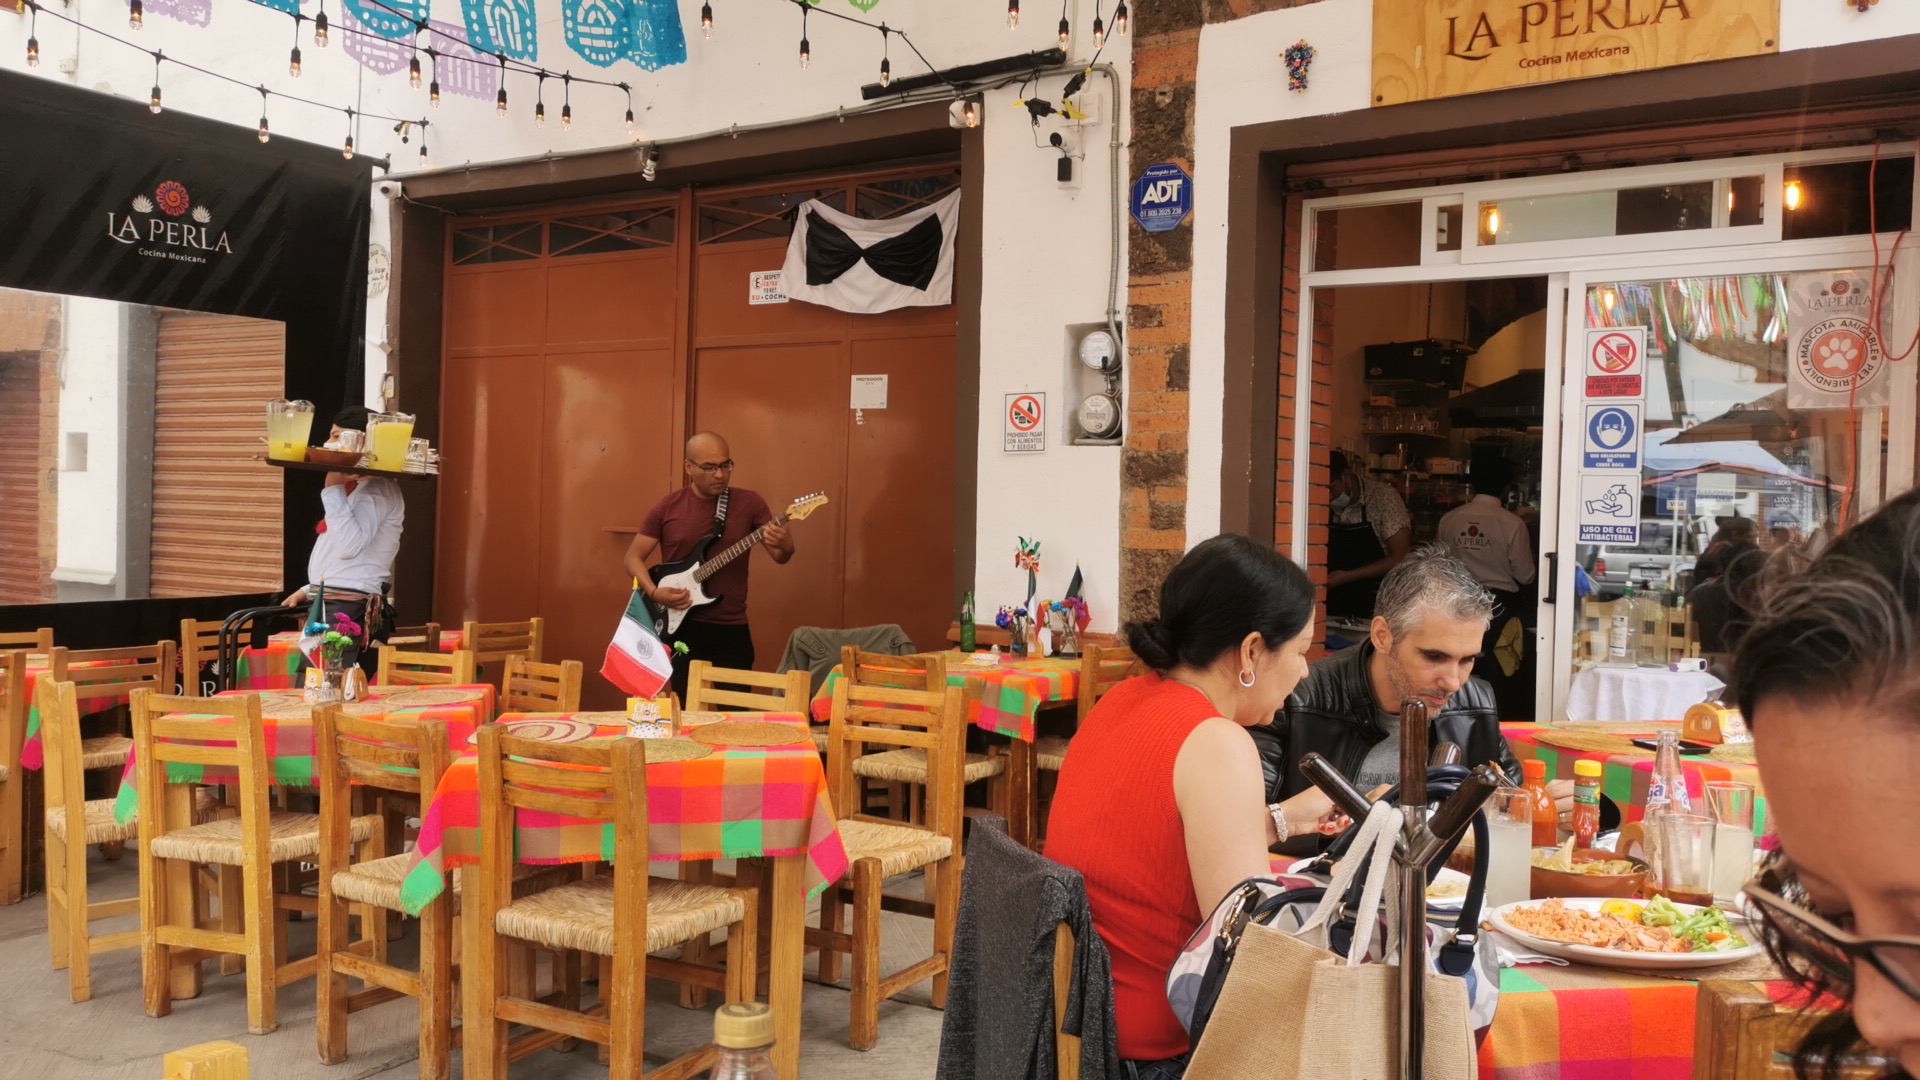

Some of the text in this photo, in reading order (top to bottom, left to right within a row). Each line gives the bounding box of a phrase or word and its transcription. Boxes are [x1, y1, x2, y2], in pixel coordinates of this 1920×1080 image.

[1445, 0, 1695, 61] LA PERLA
[1518, 44, 1630, 69] Cocina Mexicana
[1141, 179, 1182, 205] ADT
[107, 212, 233, 254] LA PERLA
[138, 248, 207, 264] Cocina Mexicana
[1807, 295, 1872, 312] LA PERLA
[1800, 320, 1879, 359] MASCOTA AMIGABLE
[1856, 363, 1874, 381] PET
[1581, 533, 1634, 542] ANTIBACTERIAL
[1616, 526, 1633, 534] GEL
[1464, 538, 1492, 547] PERLA
